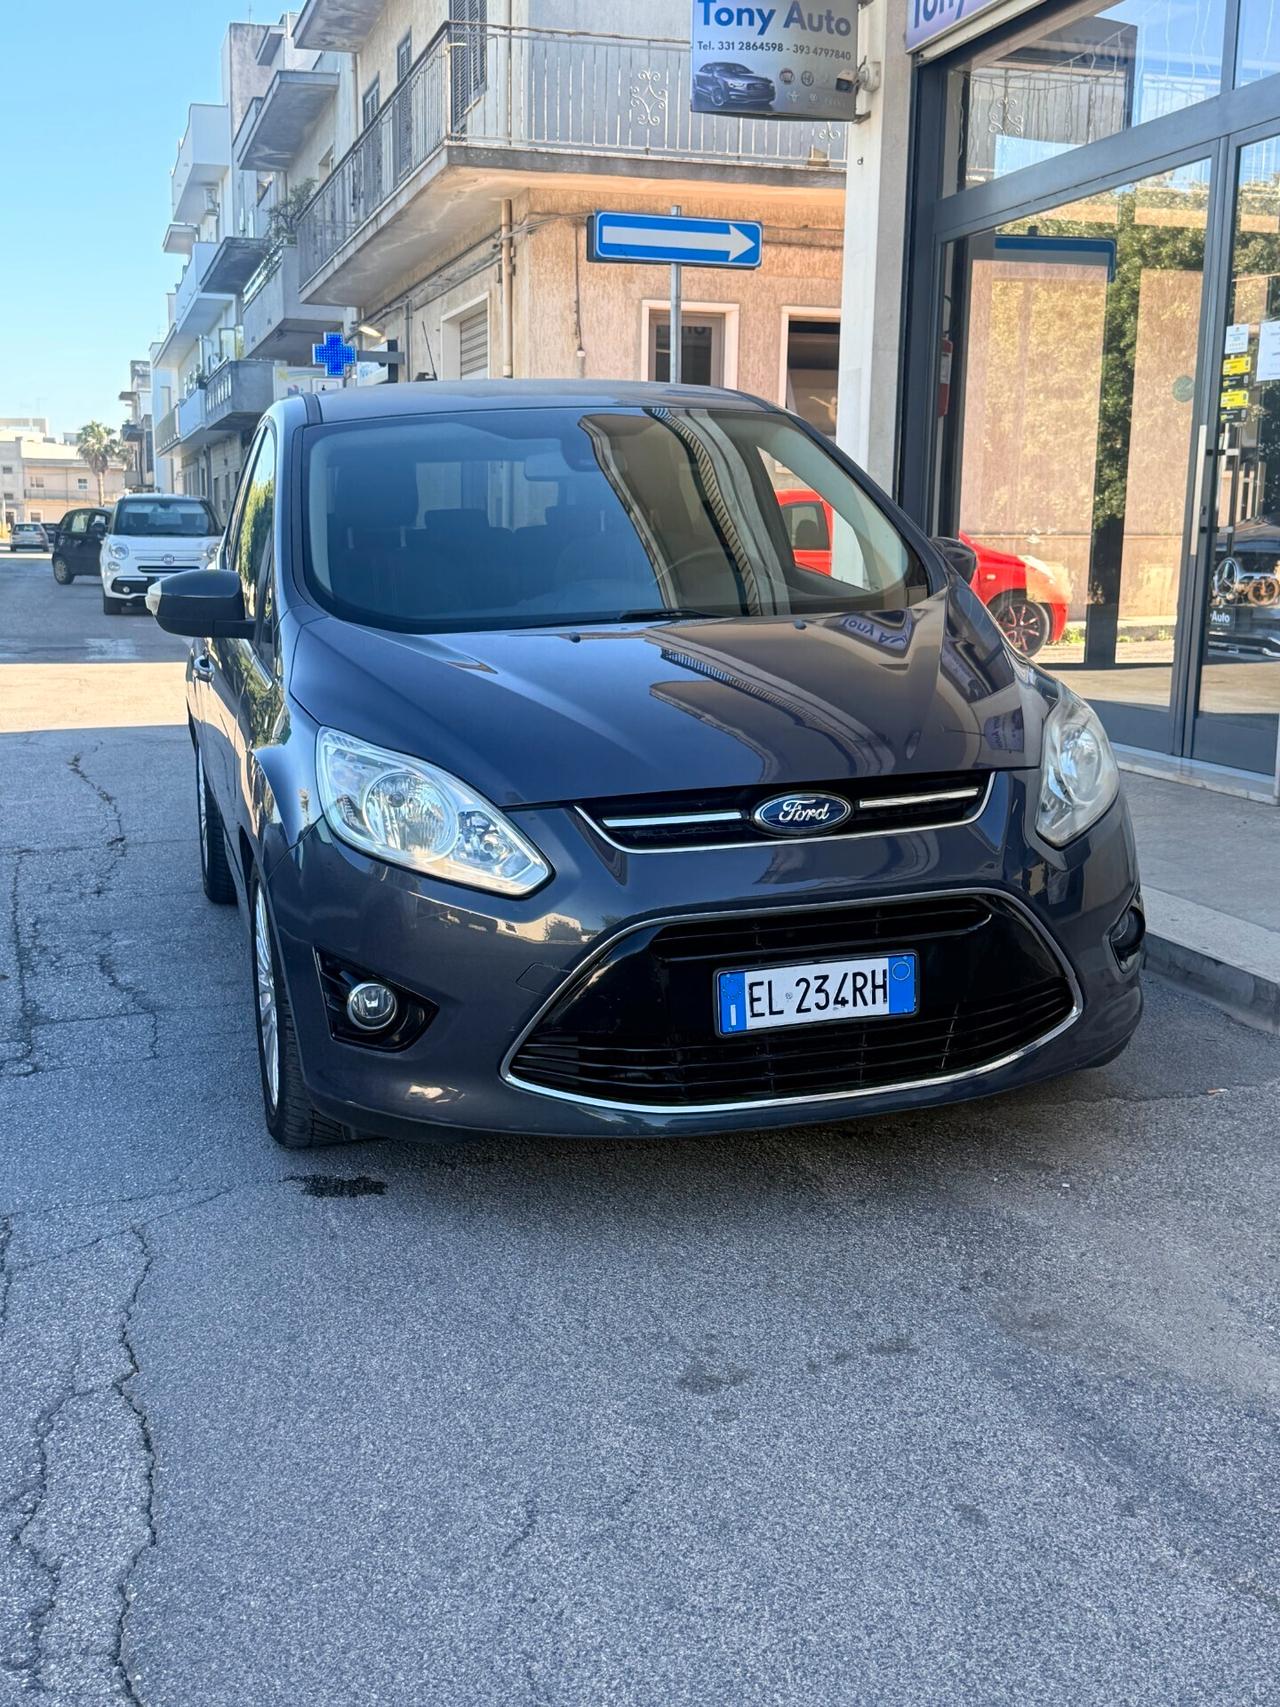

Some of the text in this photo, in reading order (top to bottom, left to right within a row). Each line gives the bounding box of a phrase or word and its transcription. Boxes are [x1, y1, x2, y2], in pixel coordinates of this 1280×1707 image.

[697, 0, 852, 37] Tony Auto
[697, 41, 715, 51] Tel.
[718, 41, 735, 50] 331
[738, 42, 784, 53] 2864598
[793, 44, 810, 55] 393
[812, 47, 851, 61] 4797840
[1211, 610, 1230, 623] Auto
[778, 798, 830, 823] Ford
[748, 968, 888, 1018] EL 234RH
